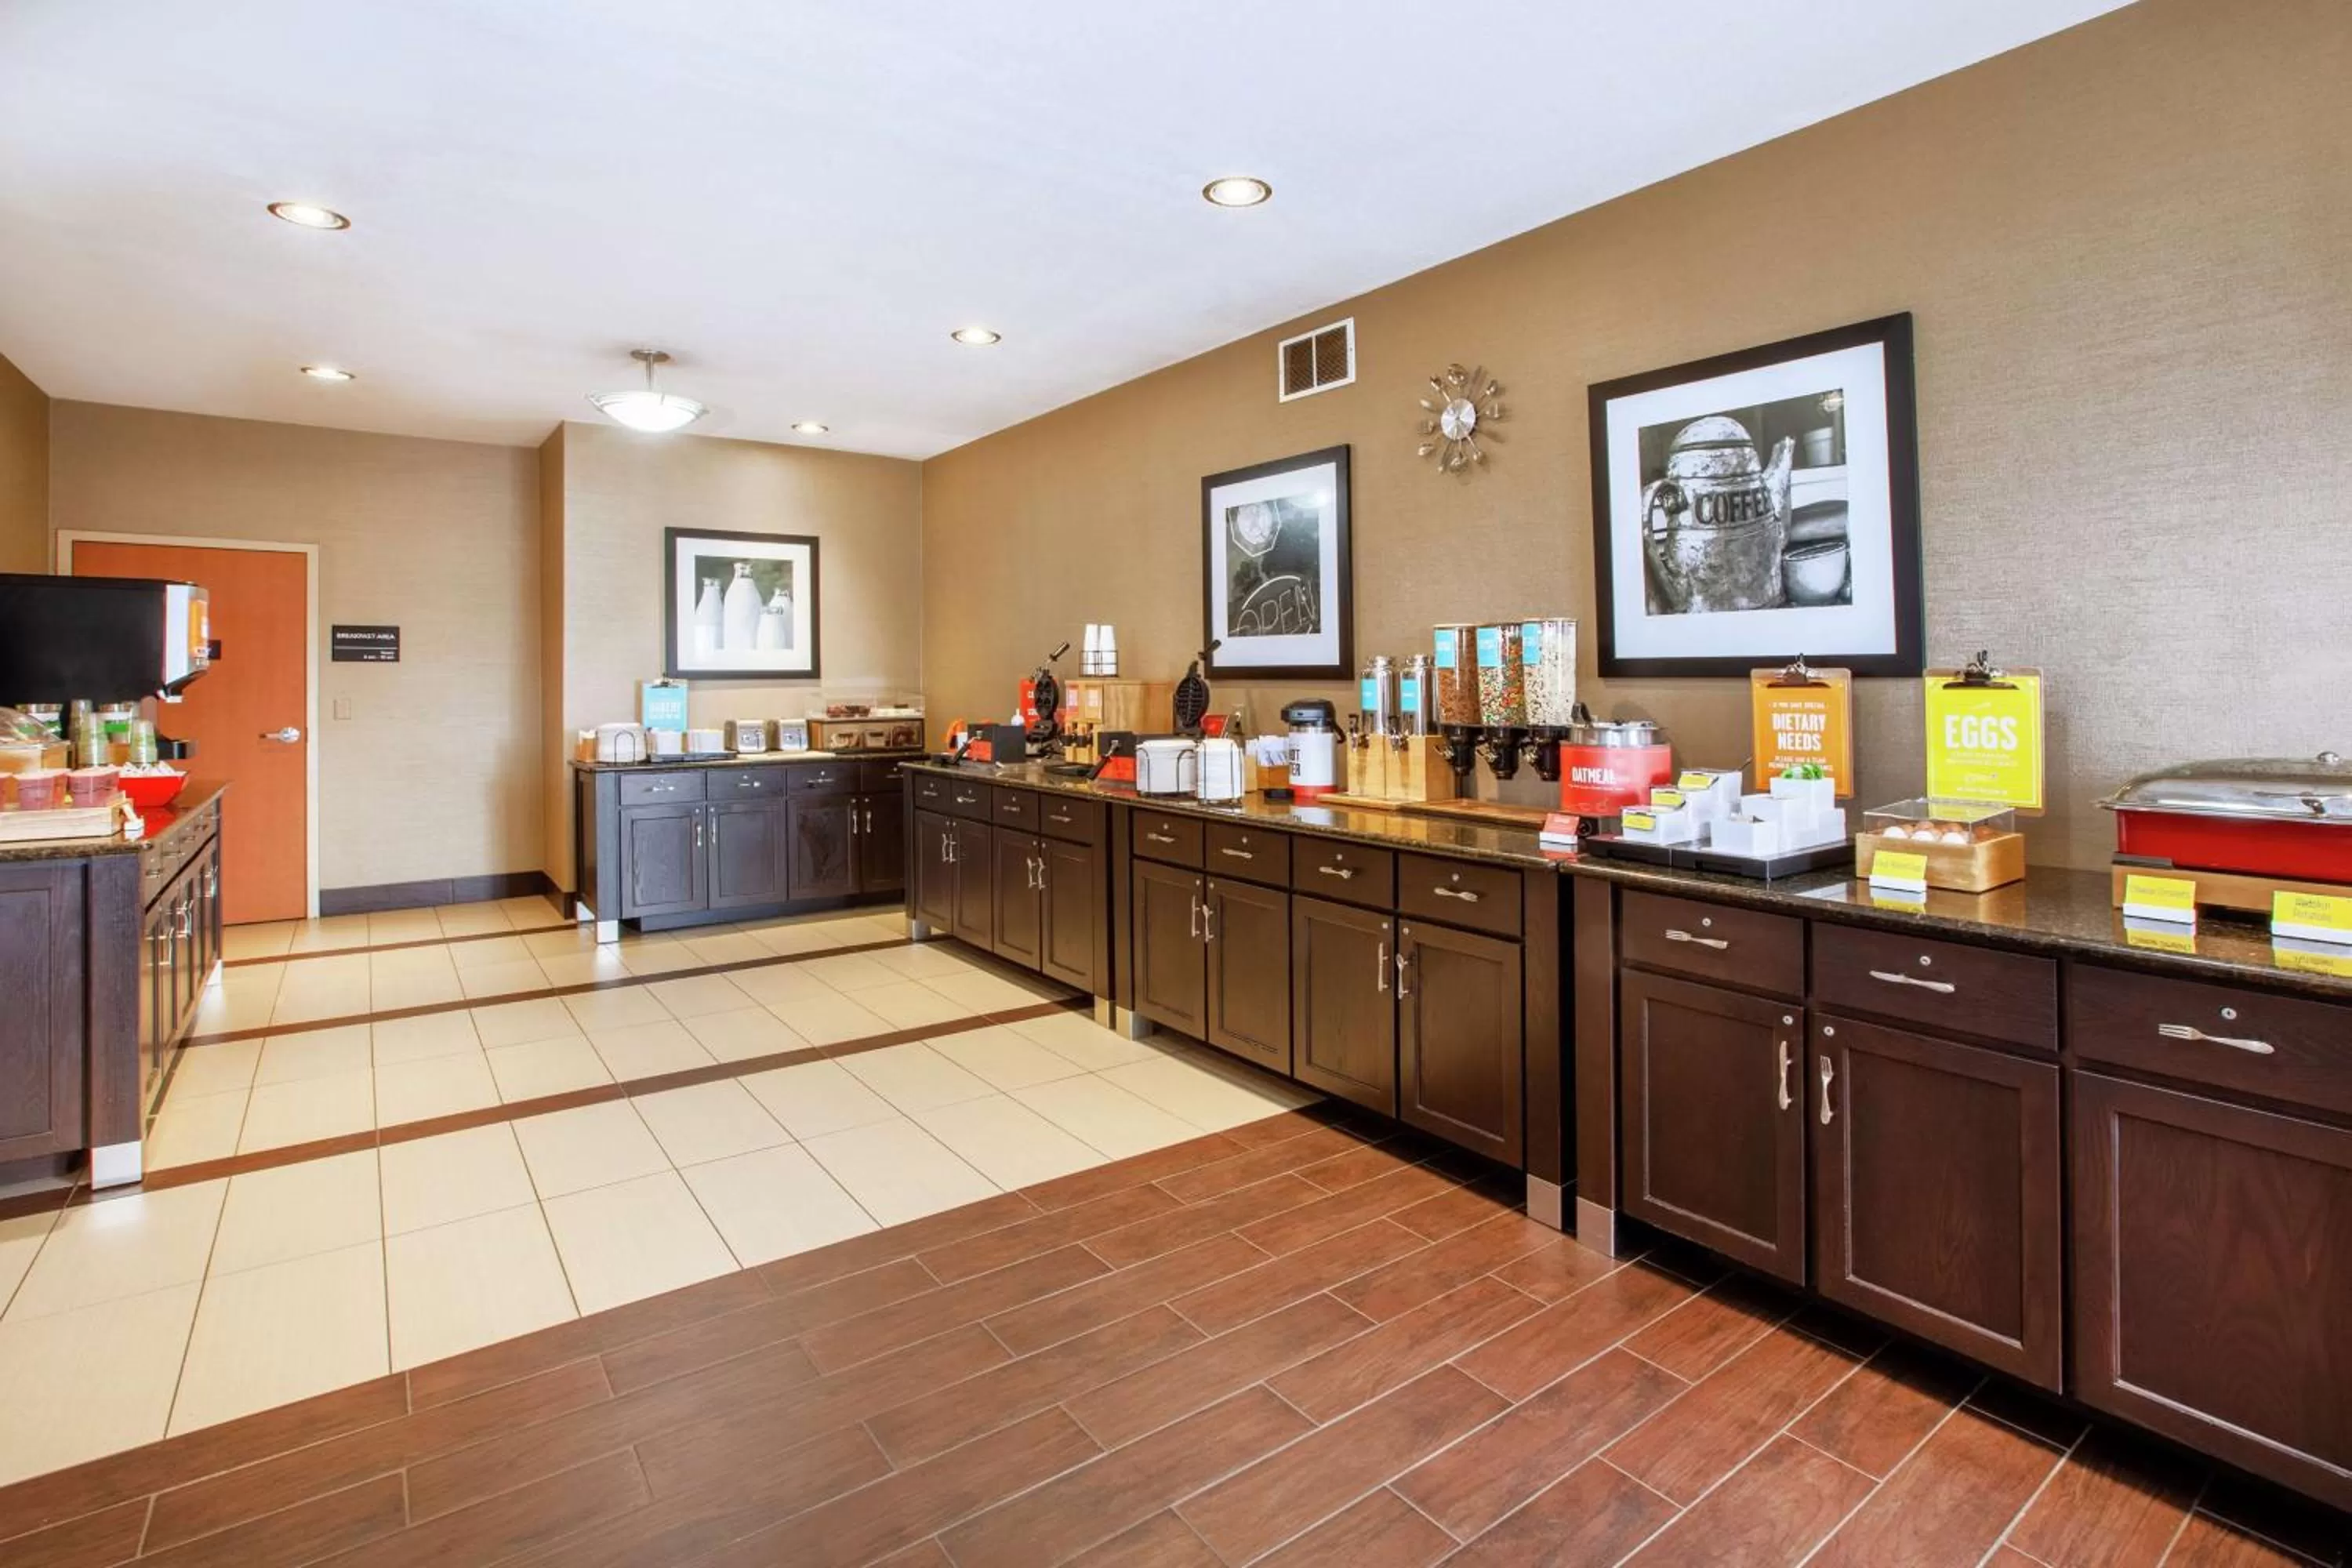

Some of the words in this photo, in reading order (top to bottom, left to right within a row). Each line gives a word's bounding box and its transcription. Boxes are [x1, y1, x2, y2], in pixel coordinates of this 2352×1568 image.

[1694, 488, 1771, 525] COFFEE
[1237, 580, 1316, 635] OPEN
[1772, 713, 1826, 731] DIETARY
[1945, 714, 2018, 751] EGGS
[1777, 732, 1823, 751] NEEDS
[1572, 767, 1617, 784] OATMEAL
